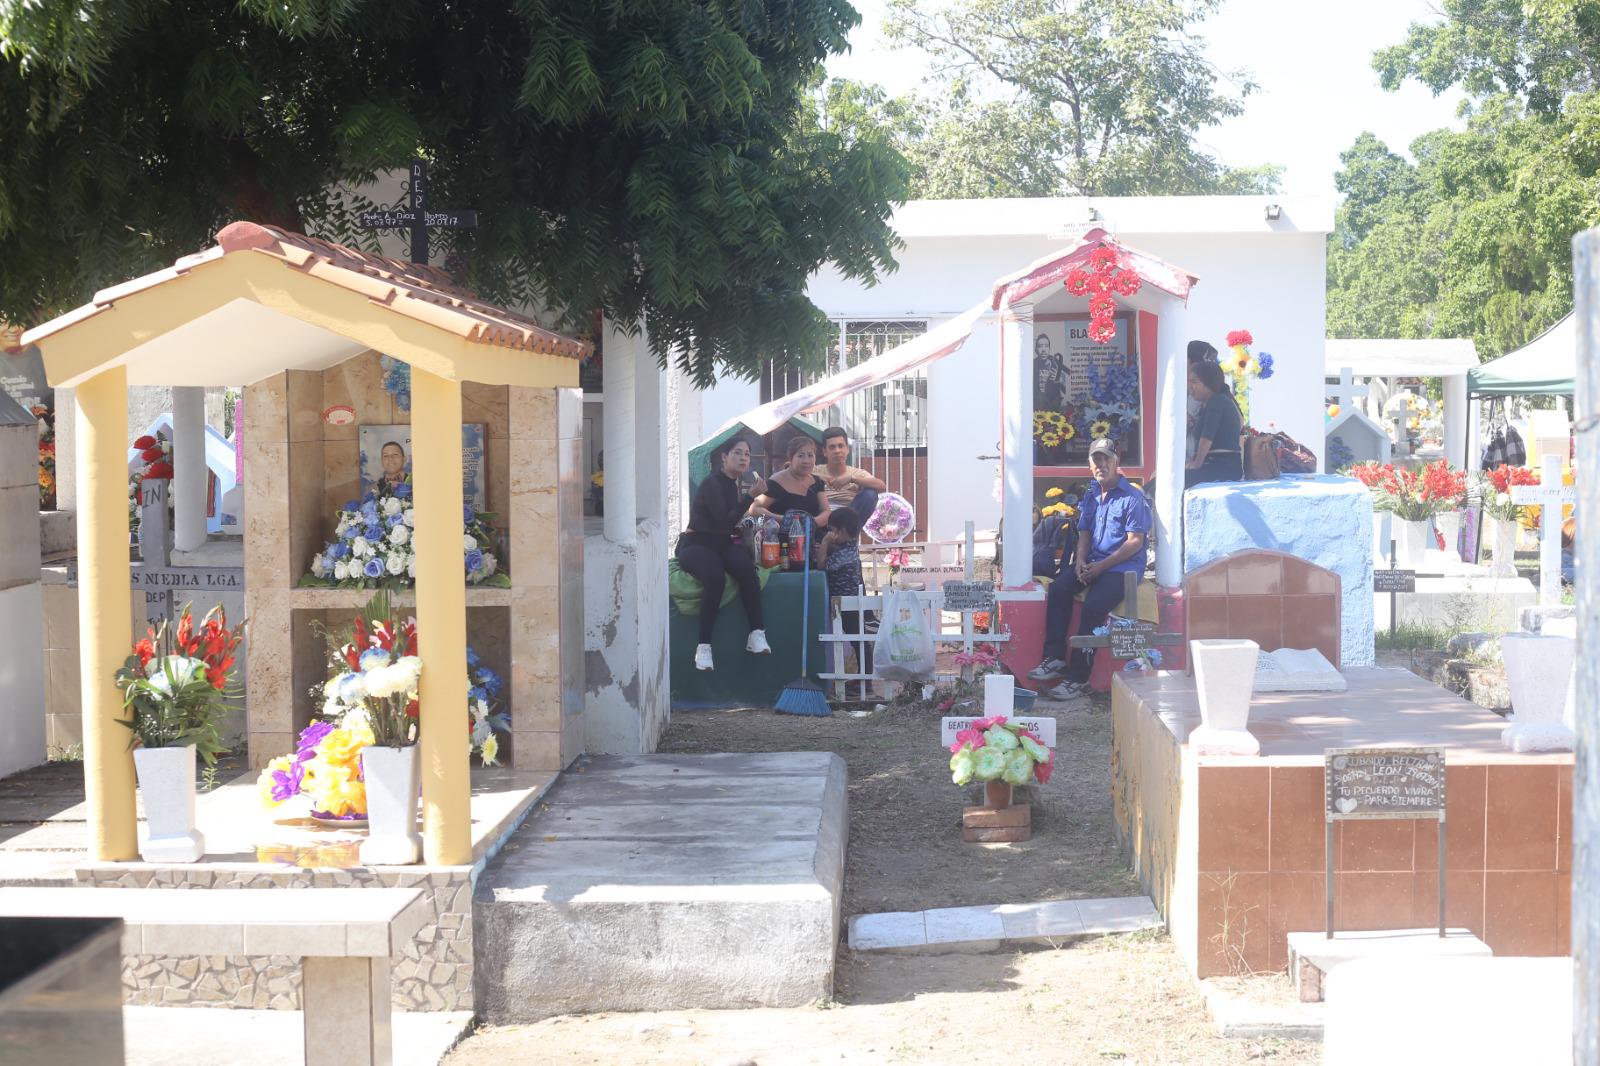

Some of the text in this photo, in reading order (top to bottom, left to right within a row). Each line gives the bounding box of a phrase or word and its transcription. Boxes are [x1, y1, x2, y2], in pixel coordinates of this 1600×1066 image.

[145, 573, 200, 586] NIEBLA
[1373, 765, 1403, 776] LEON
[1338, 785, 1352, 797] TU
